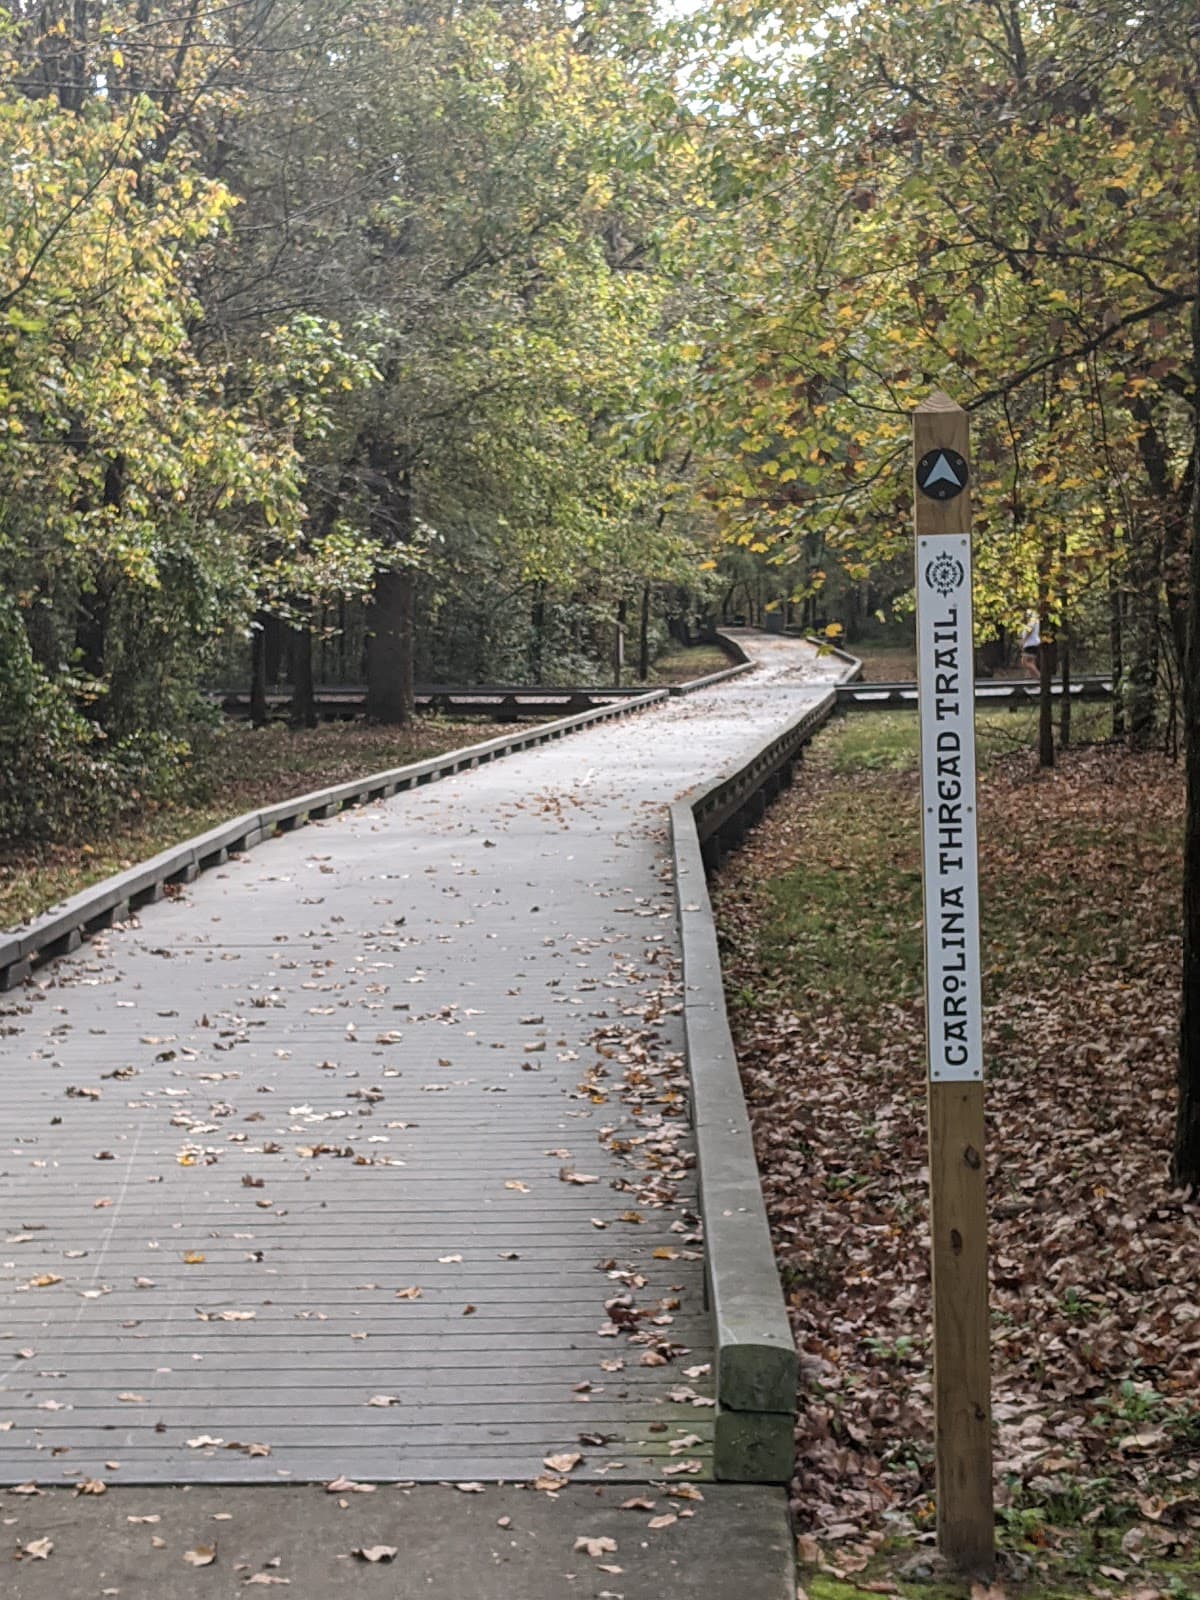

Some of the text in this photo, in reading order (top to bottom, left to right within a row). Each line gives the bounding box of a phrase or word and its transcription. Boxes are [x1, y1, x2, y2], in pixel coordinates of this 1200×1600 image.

[933, 608, 968, 1066] CAROLINA THREAD TRAIL
